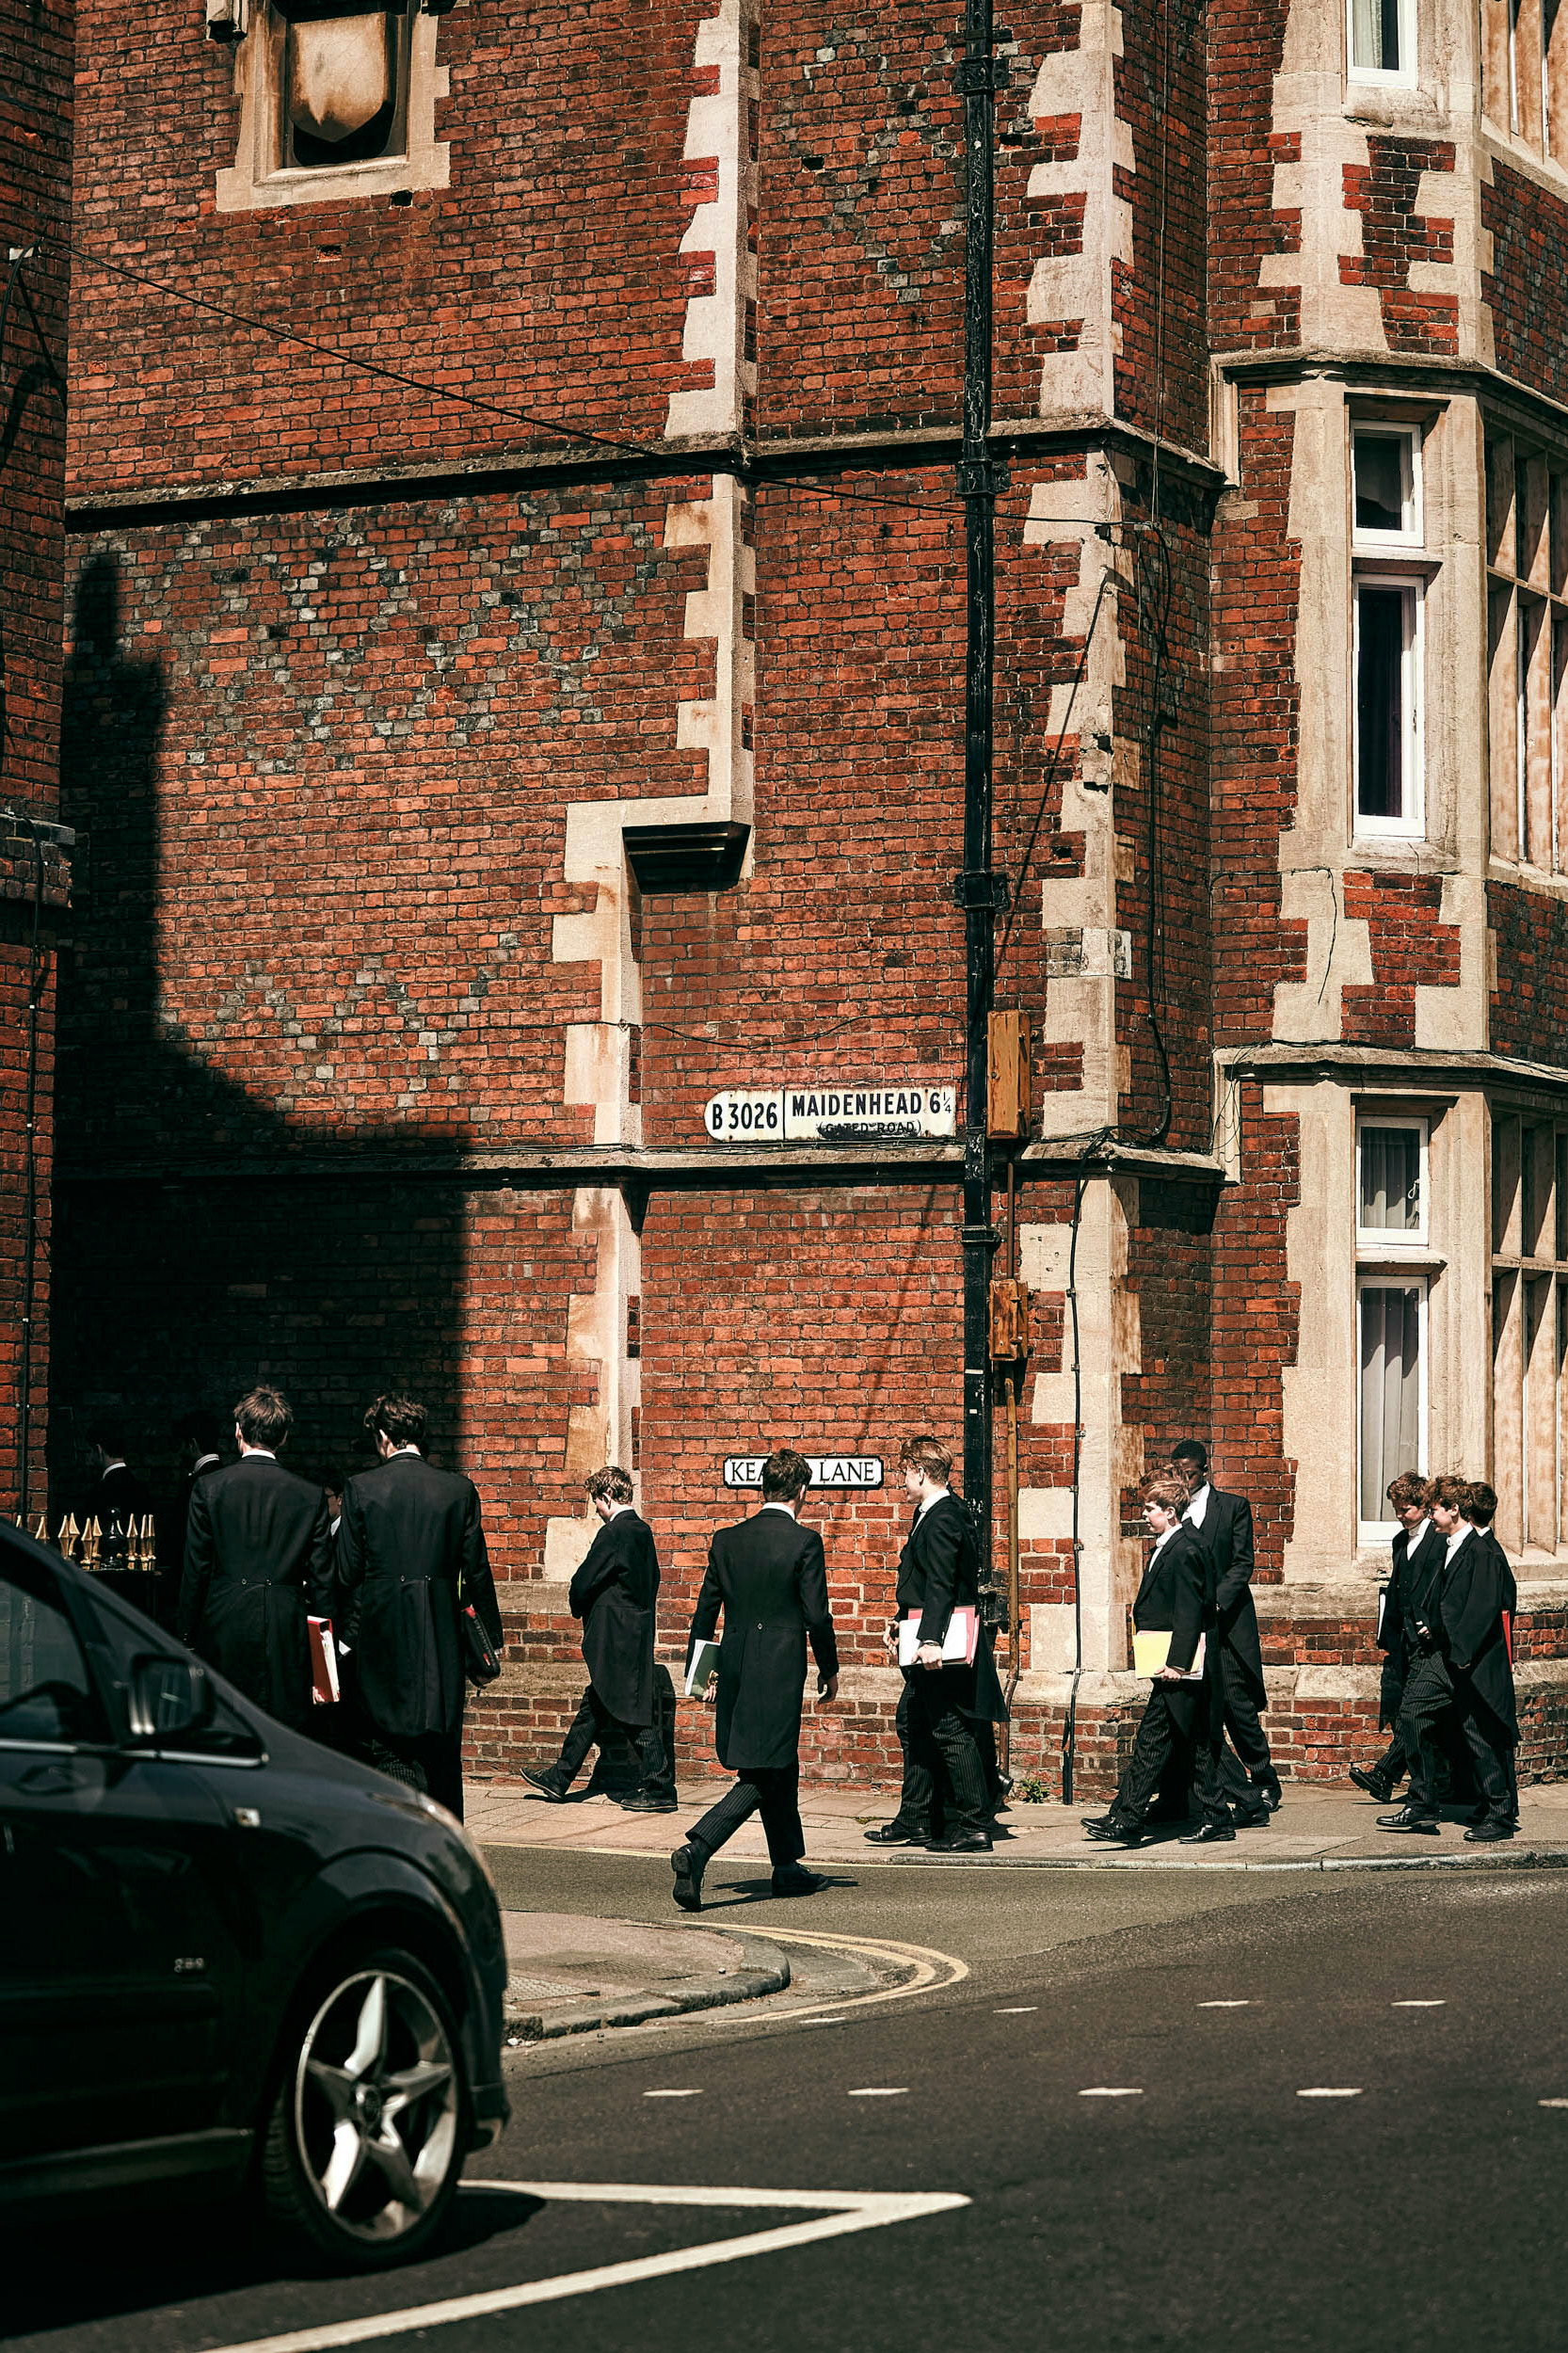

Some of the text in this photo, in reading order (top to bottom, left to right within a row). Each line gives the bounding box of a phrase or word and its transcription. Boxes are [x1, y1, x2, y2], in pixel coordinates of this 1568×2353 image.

[728, 1101, 778, 1129] 3026
[792, 1092, 922, 1117] MAIDENHEAD
[819, 1461, 875, 1482] LANE
